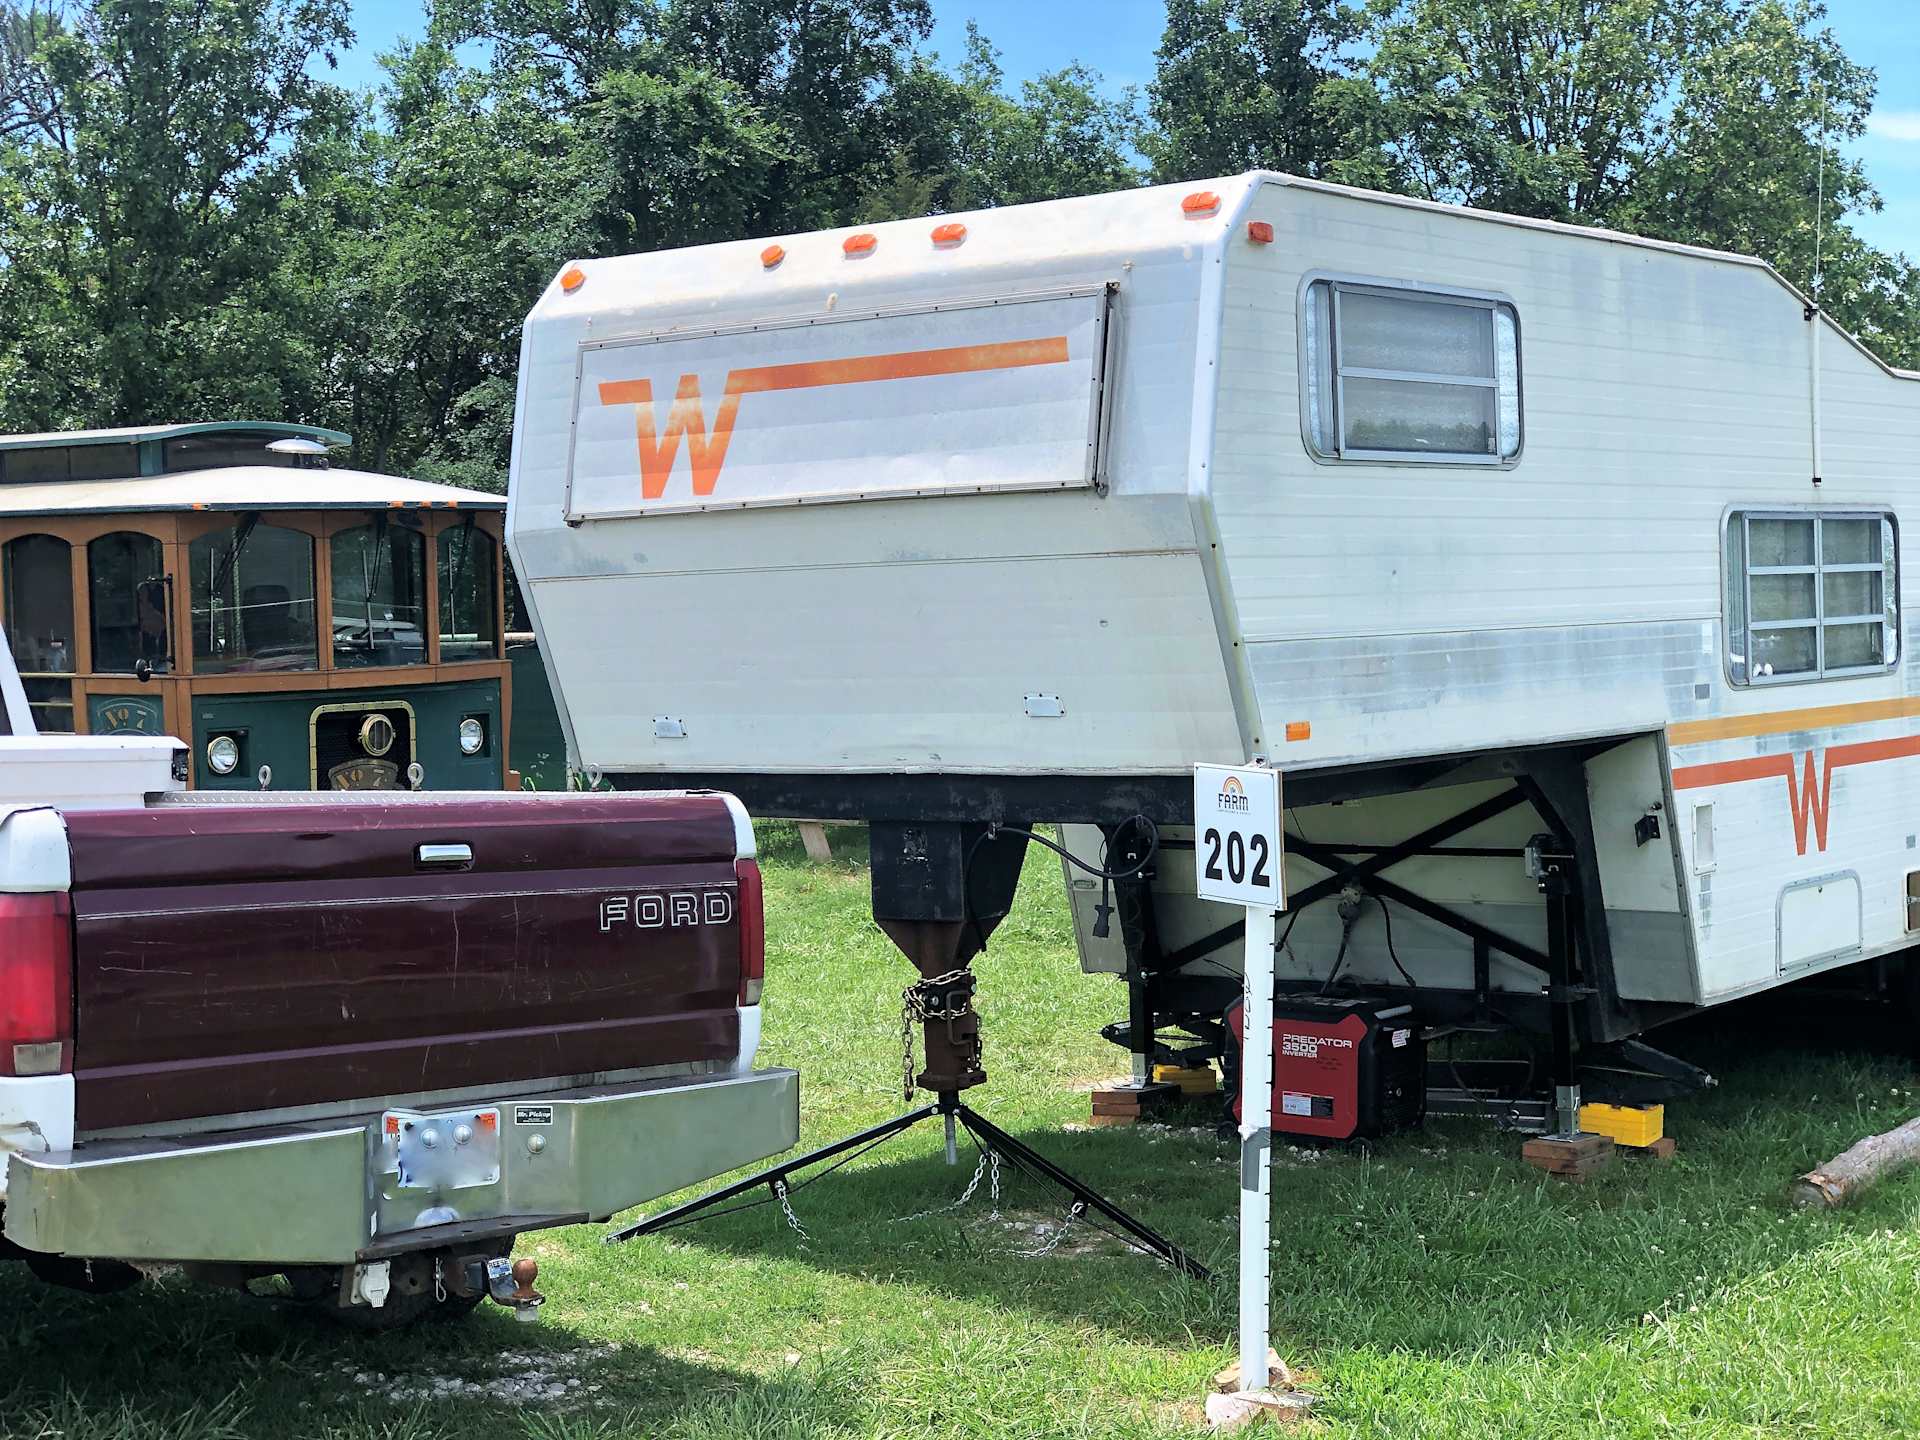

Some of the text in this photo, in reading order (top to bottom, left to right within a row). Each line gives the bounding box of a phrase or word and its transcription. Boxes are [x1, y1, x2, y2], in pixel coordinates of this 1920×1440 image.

[632, 373, 743, 499] W
[136, 709, 148, 729] 7
[1217, 792, 1250, 812] FARM
[1786, 748, 1833, 856] W
[1204, 828, 1271, 888] 202
[600, 891, 733, 932] FORD
[1282, 1033, 1353, 1049] PREDATOR
[1282, 1041, 1318, 1053] 3500
[1281, 1049, 1318, 1059] INVERTER
